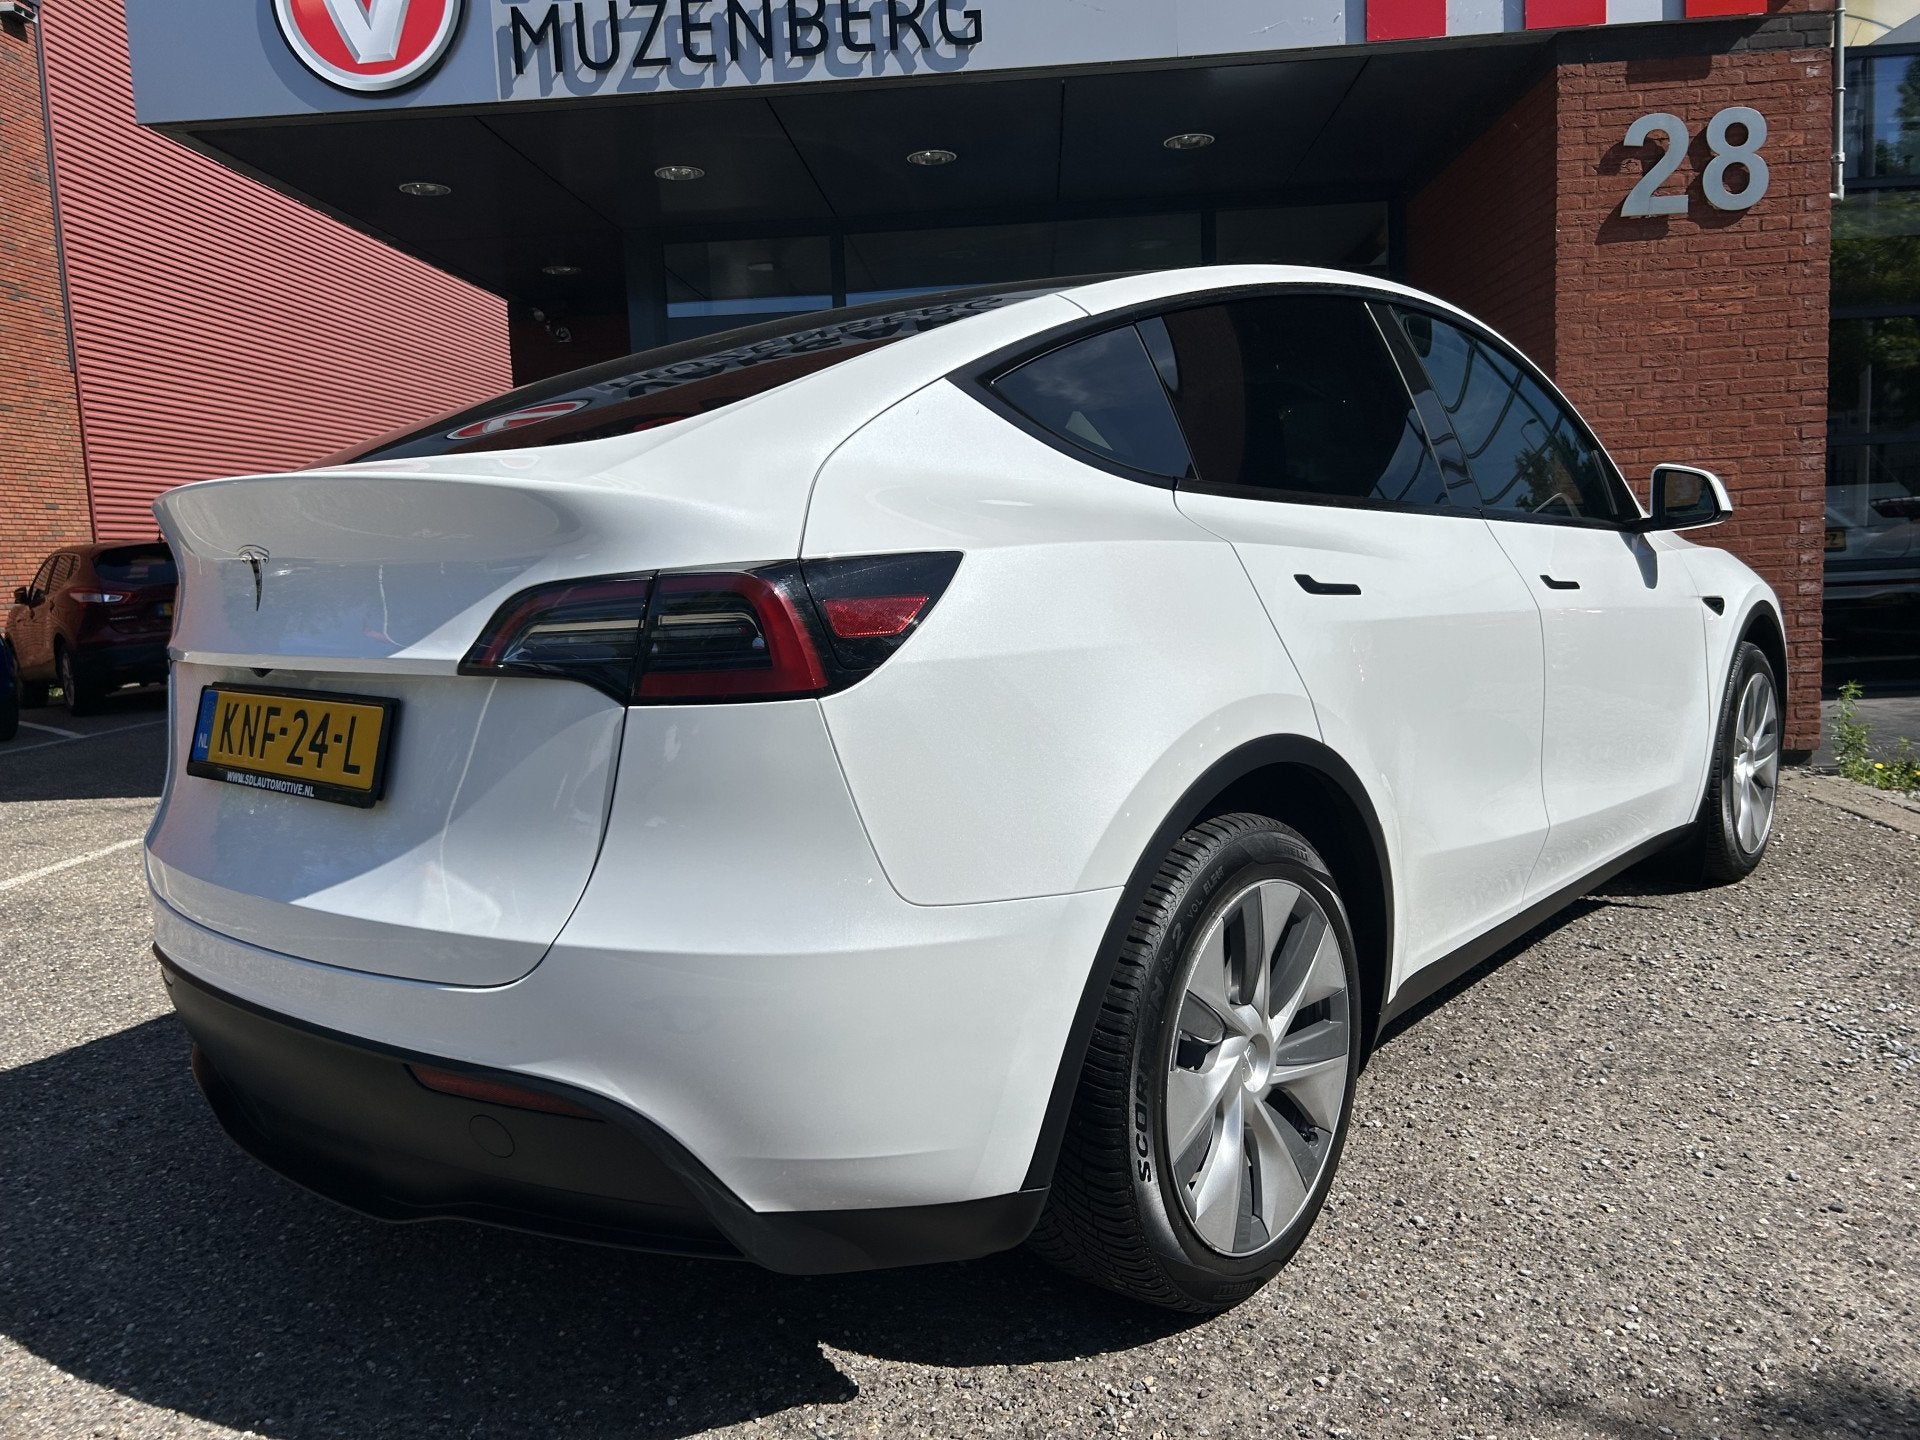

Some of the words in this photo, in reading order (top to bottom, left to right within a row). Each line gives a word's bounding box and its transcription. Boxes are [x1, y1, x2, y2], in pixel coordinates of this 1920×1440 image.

[510, 0, 984, 75] MUZENBERG
[1621, 106, 1769, 217] 28
[198, 732, 208, 749] NL
[219, 702, 361, 775] KNF-24-L
[226, 771, 315, 797] WWW.SDLAUTOMOTIVE.NL
